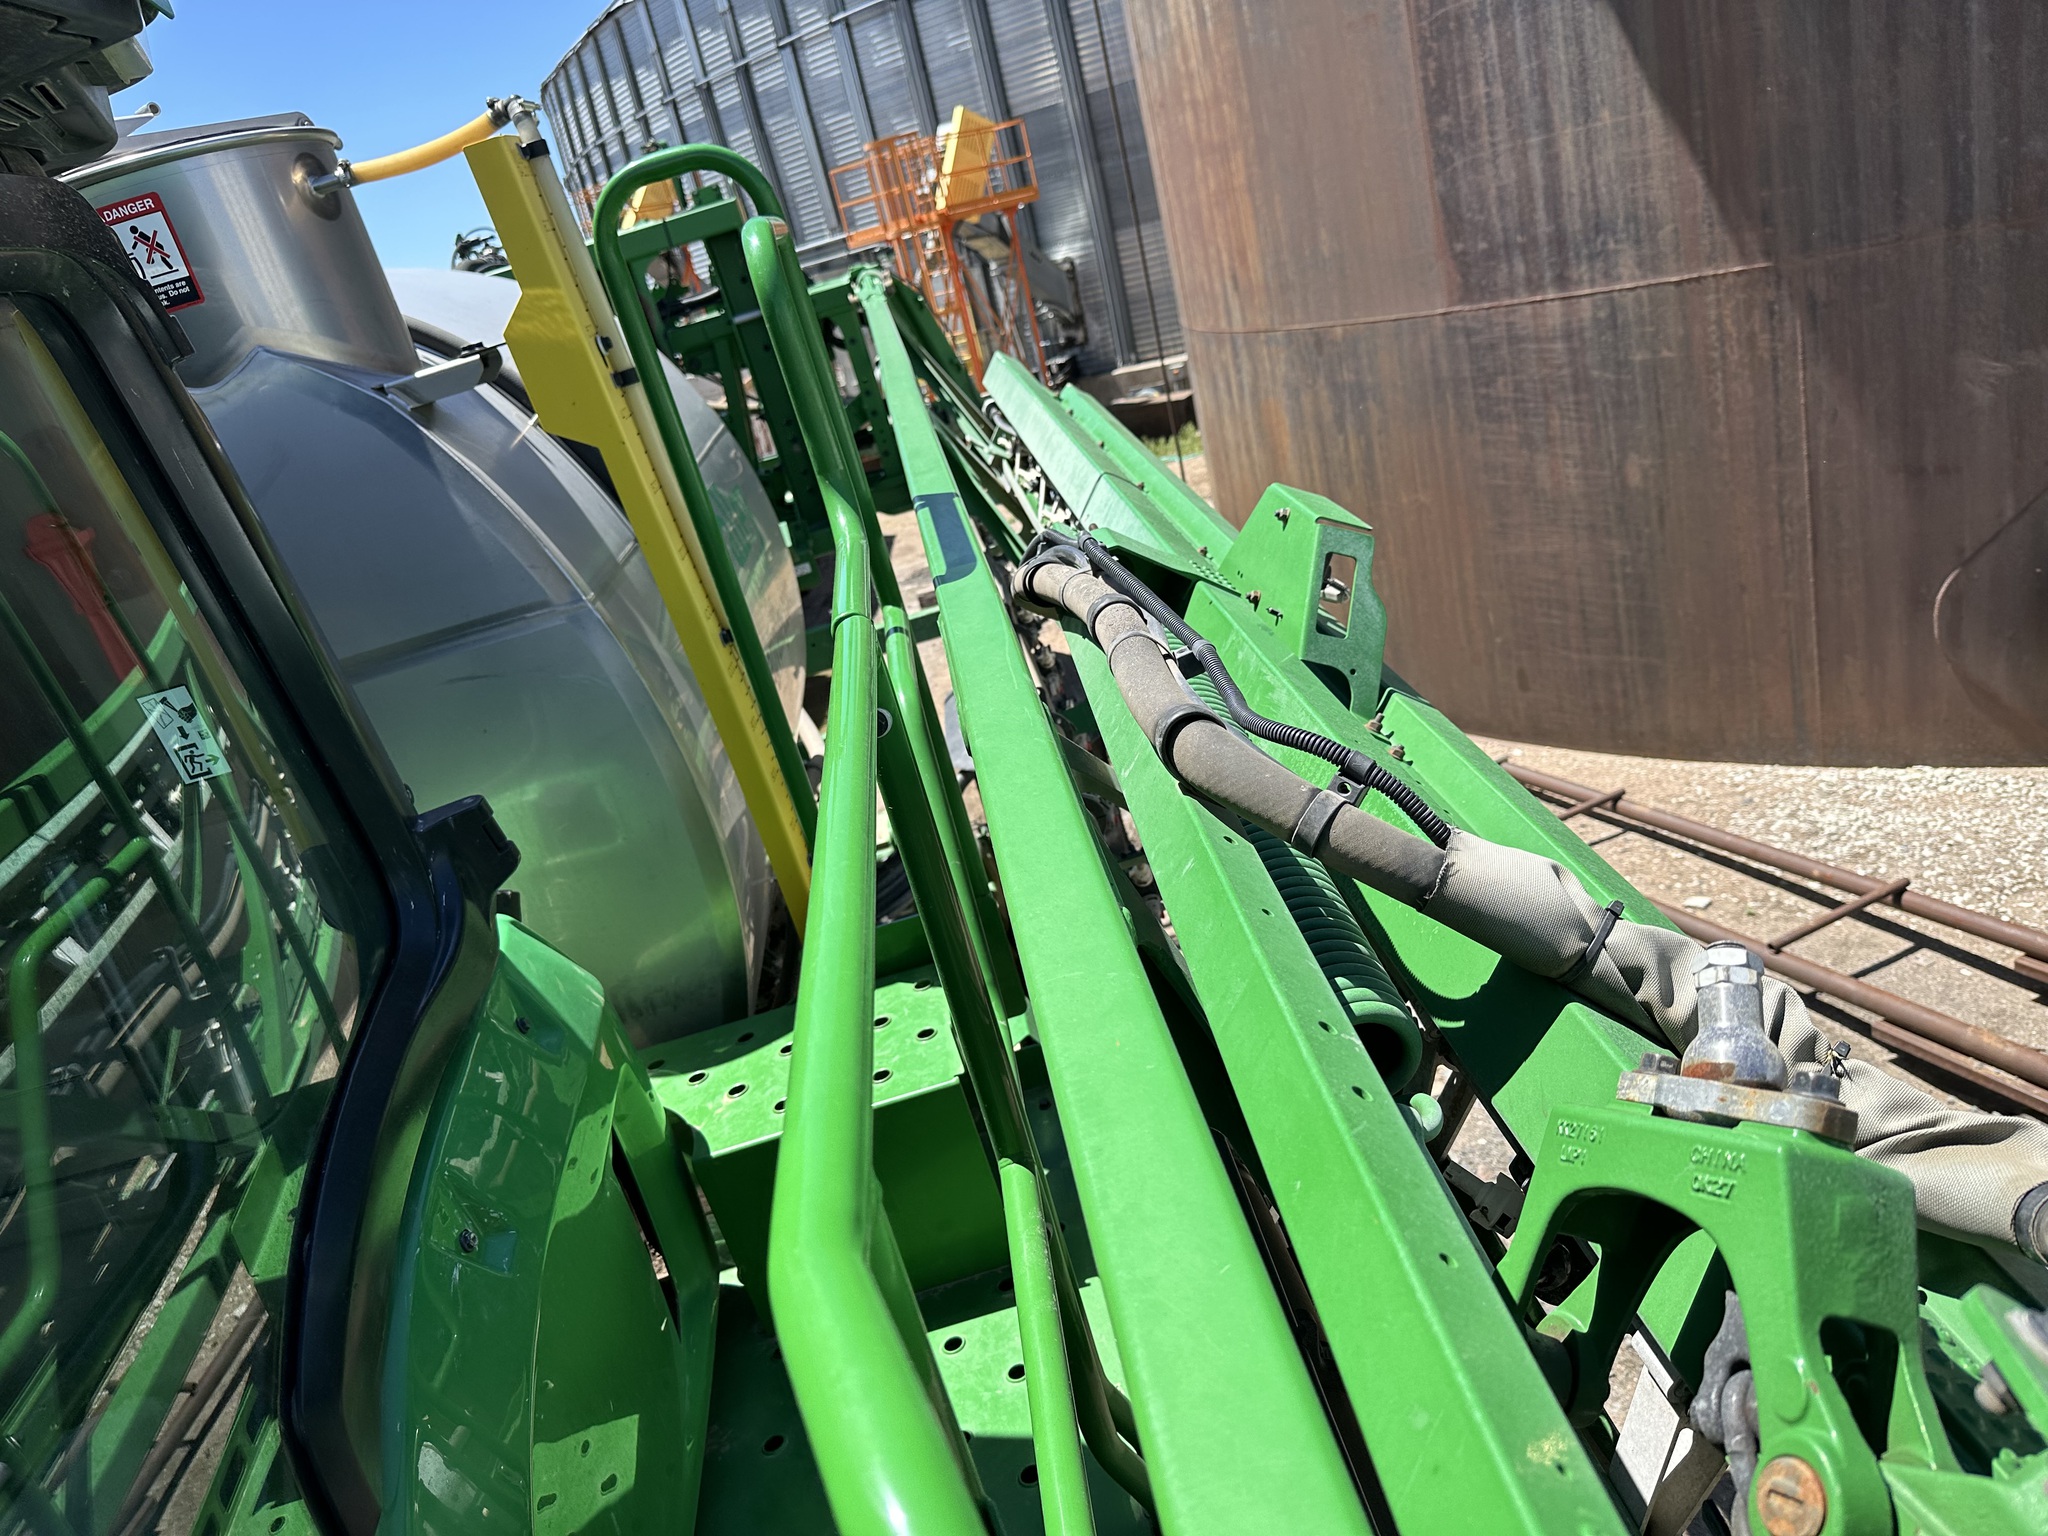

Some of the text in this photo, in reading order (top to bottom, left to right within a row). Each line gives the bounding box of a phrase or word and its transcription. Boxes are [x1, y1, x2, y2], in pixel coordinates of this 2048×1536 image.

[103, 198, 155, 222] DANGER
[154, 280, 186, 294] ntents are
[168, 289, 178, 297] Do
[178, 286, 190, 294] not
[1691, 1145, 1746, 1174] CHINA
